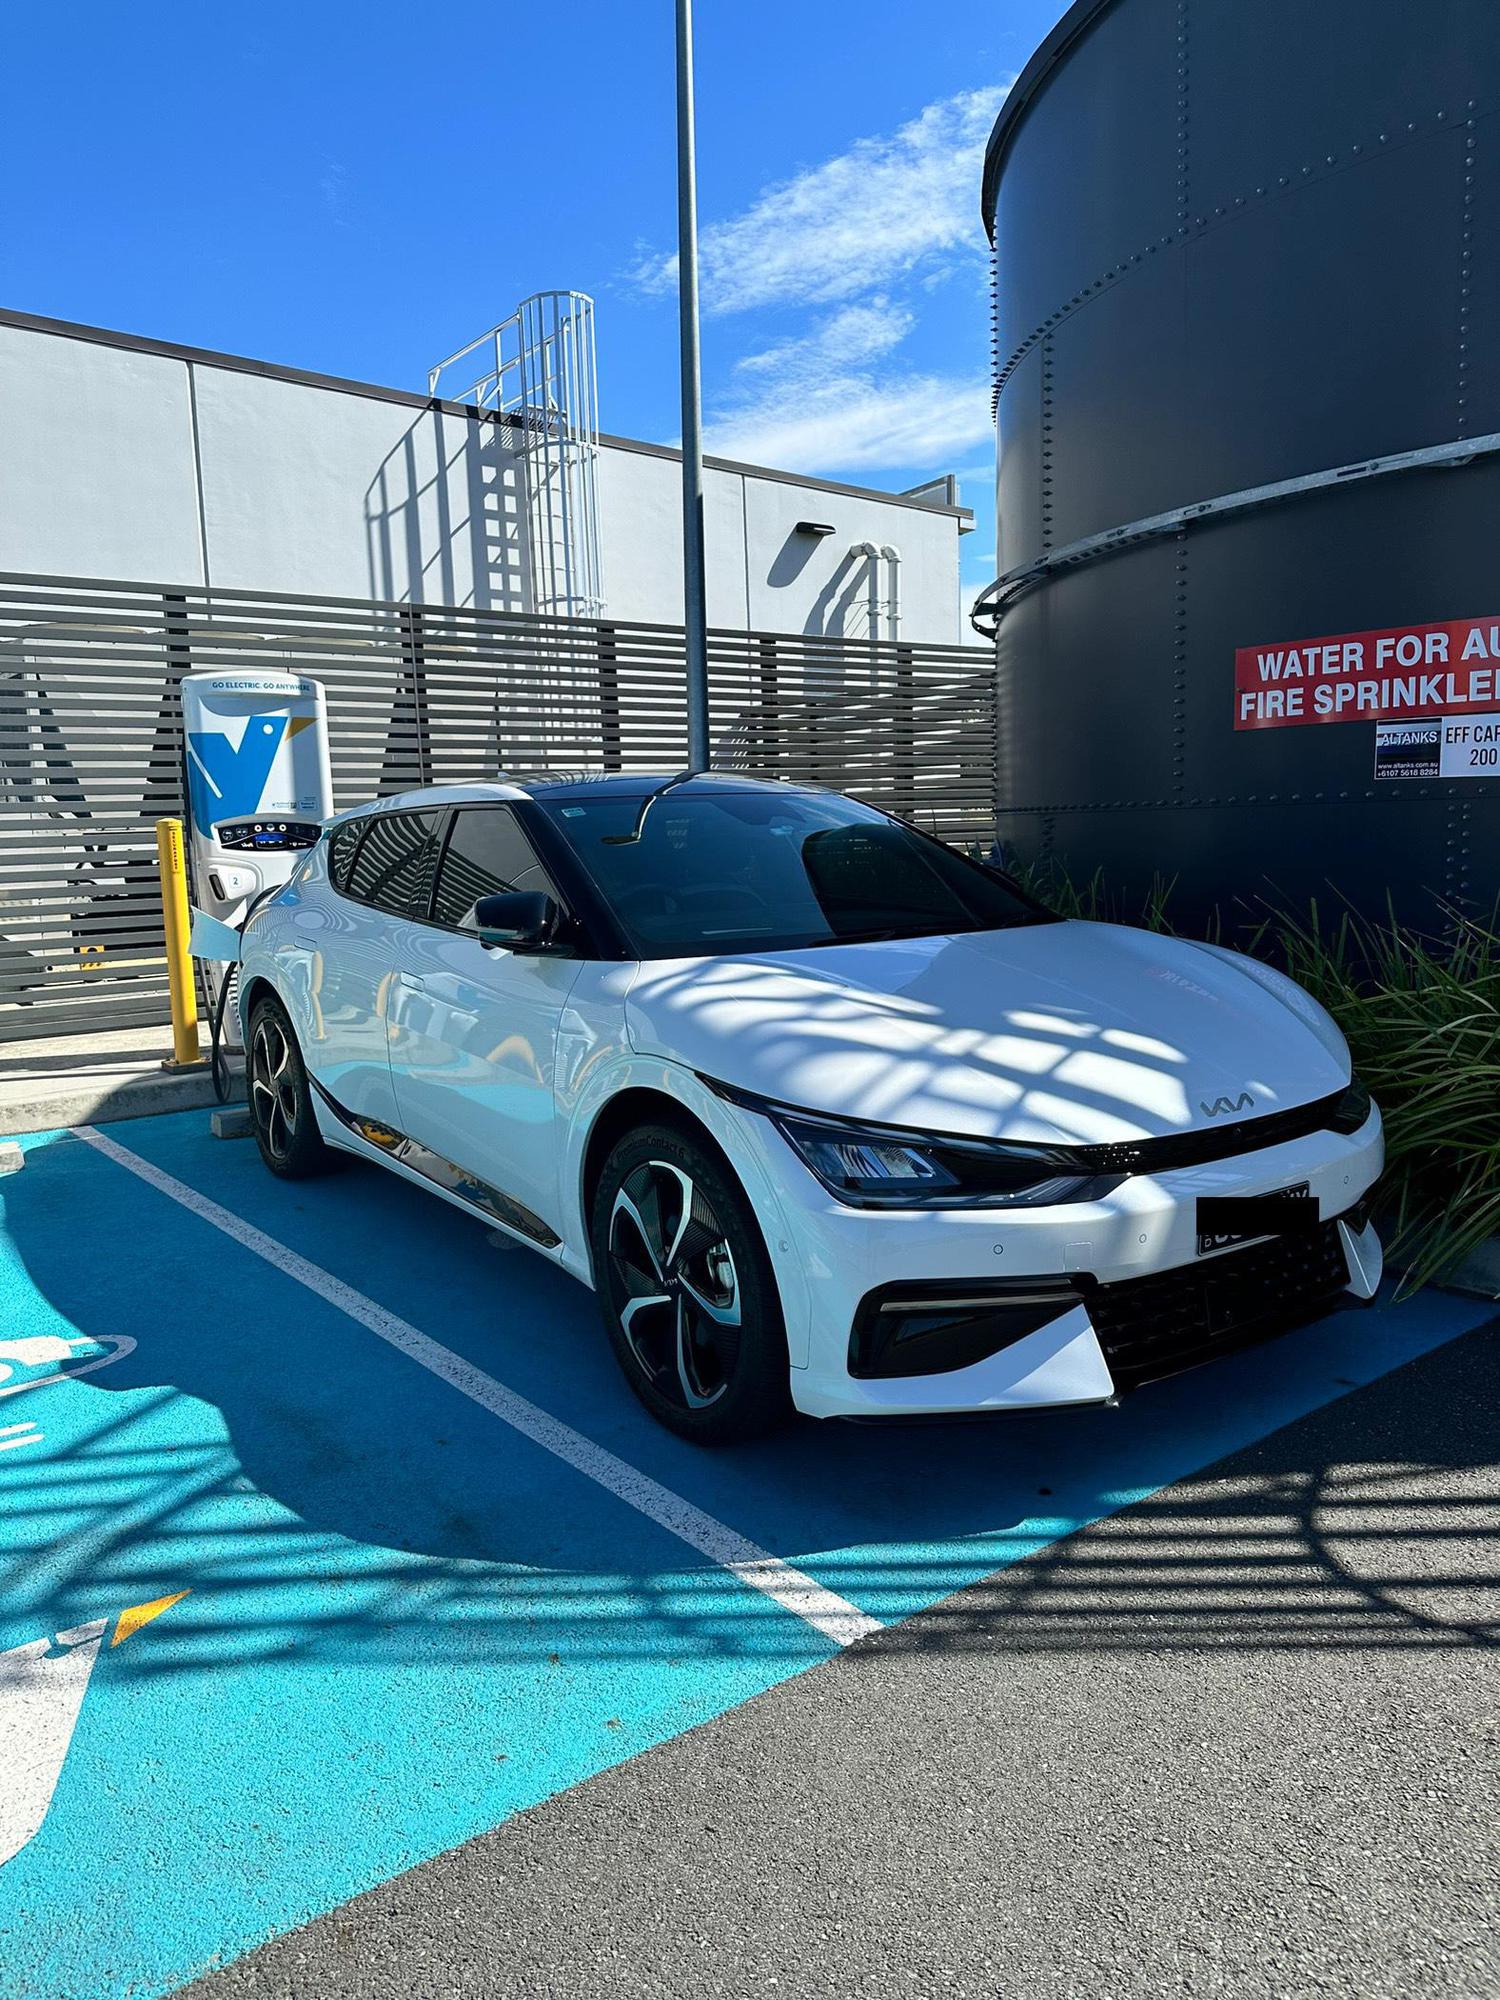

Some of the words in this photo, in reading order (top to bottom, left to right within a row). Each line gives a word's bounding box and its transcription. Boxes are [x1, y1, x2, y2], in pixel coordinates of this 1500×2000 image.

[1257, 642, 1363, 682] WATER
[1375, 632, 1449, 669] FOR
[263, 682, 274, 690] GO
[275, 683, 310, 691] ANYWHERE
[1240, 690, 1304, 721] FIRE
[1313, 669, 1500, 715] SPRINKLE
[1381, 731, 1438, 746] ALTANKS
[1446, 726, 1470, 744] EFF
[1470, 748, 1498, 766] 200
[233, 876, 239, 885] 2
[1200, 1092, 1254, 1117] KIA
